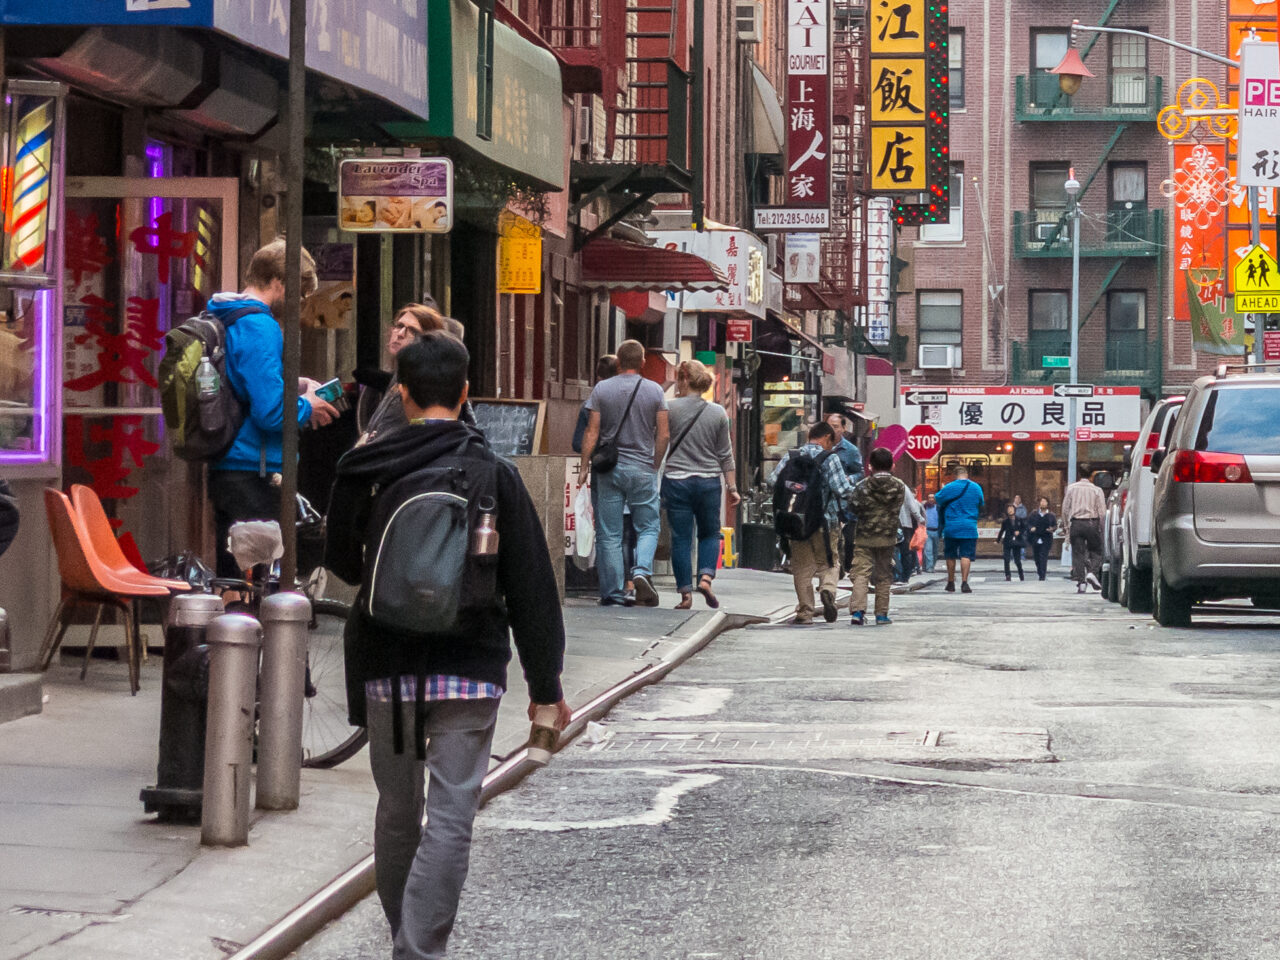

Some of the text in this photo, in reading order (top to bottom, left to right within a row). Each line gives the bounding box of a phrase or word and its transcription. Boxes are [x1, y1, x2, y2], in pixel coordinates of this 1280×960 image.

[789, 54, 826, 71] GOURMET
[1244, 108, 1277, 117] HAIR
[789, 80, 827, 198] 上海人家
[354, 163, 438, 187] Lavender Spa
[1242, 297, 1278, 308] AHEAD
[959, 401, 1105, 426] 優の良品
[907, 435, 940, 450] STOP
